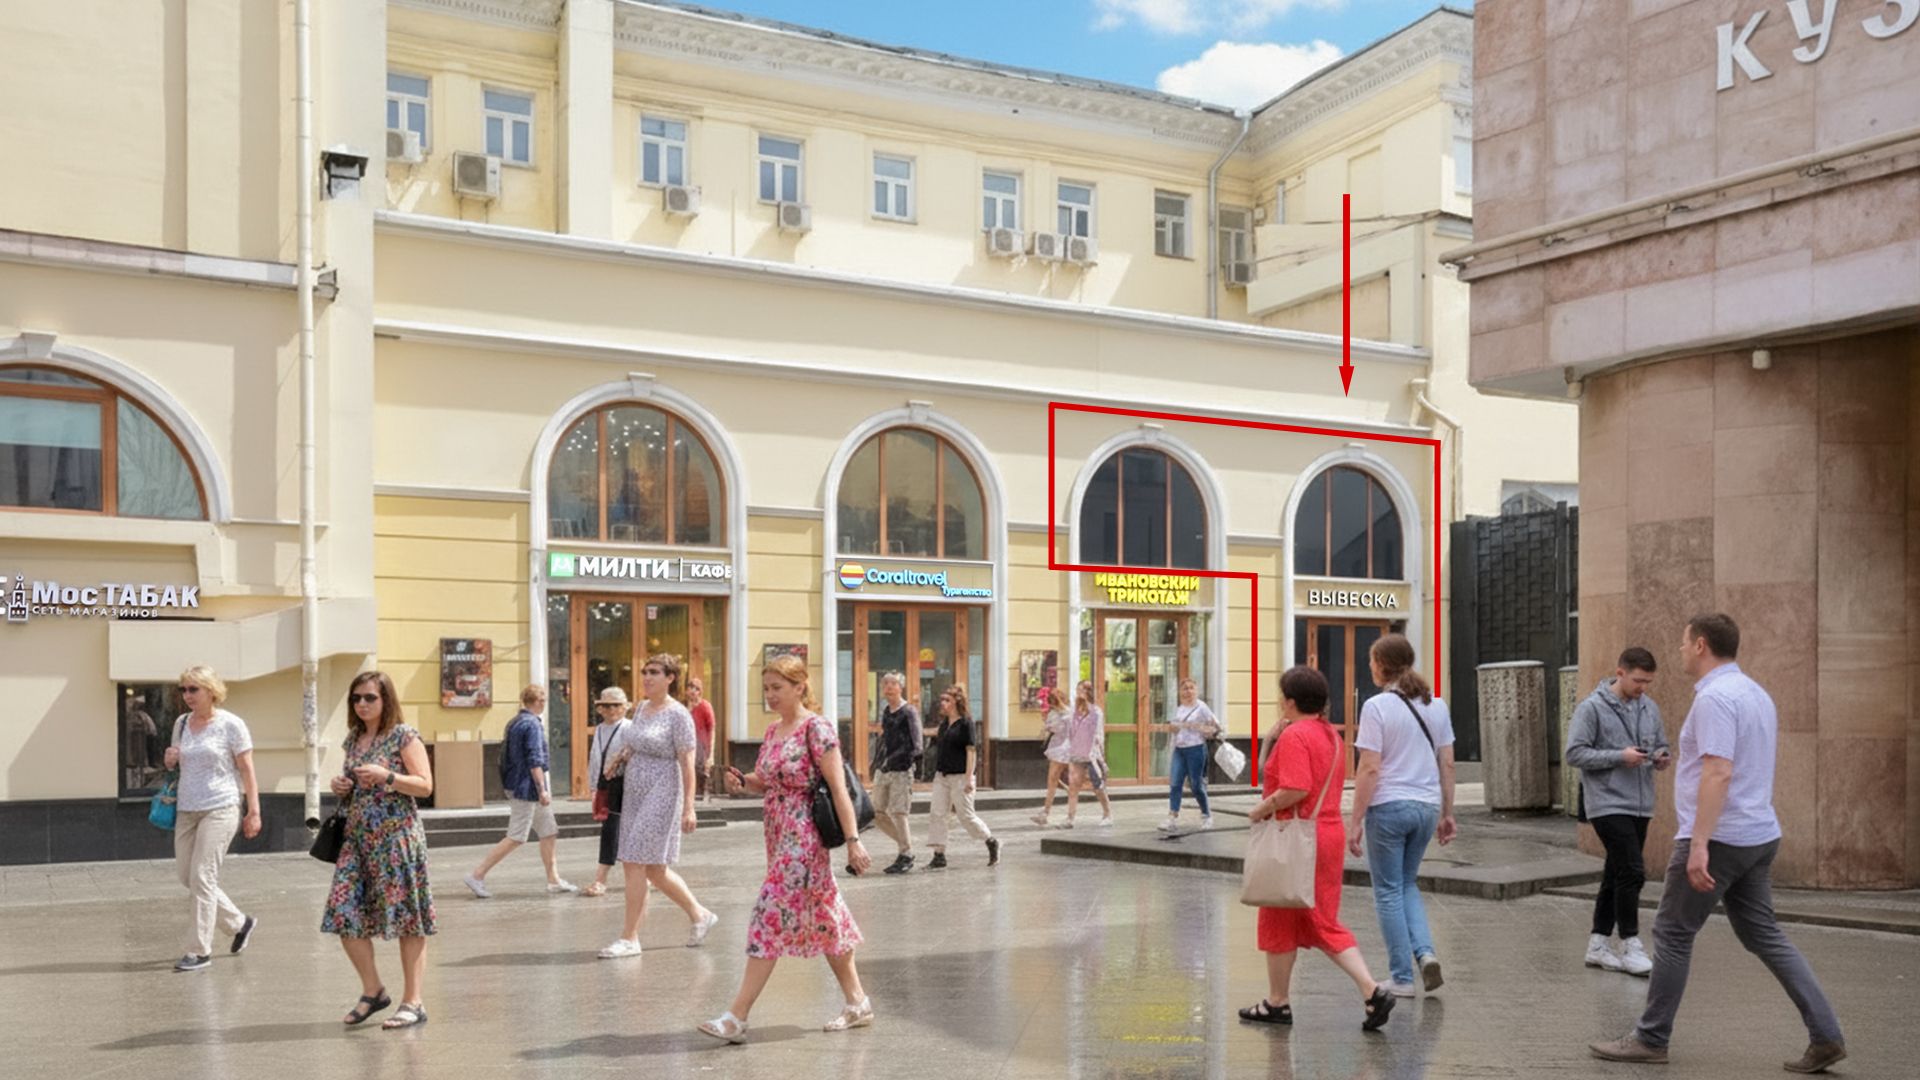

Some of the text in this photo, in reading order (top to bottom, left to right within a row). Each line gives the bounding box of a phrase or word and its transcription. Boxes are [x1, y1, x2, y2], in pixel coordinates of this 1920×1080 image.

[578, 555, 670, 579] МИЛТИ
[1107, 587, 1190, 605] ТРИКОТАЖ
[1308, 588, 1398, 609] ВЫВЕСКА
[32, 605, 158, 618] СЕТЬ МАГАЗИНОВ
